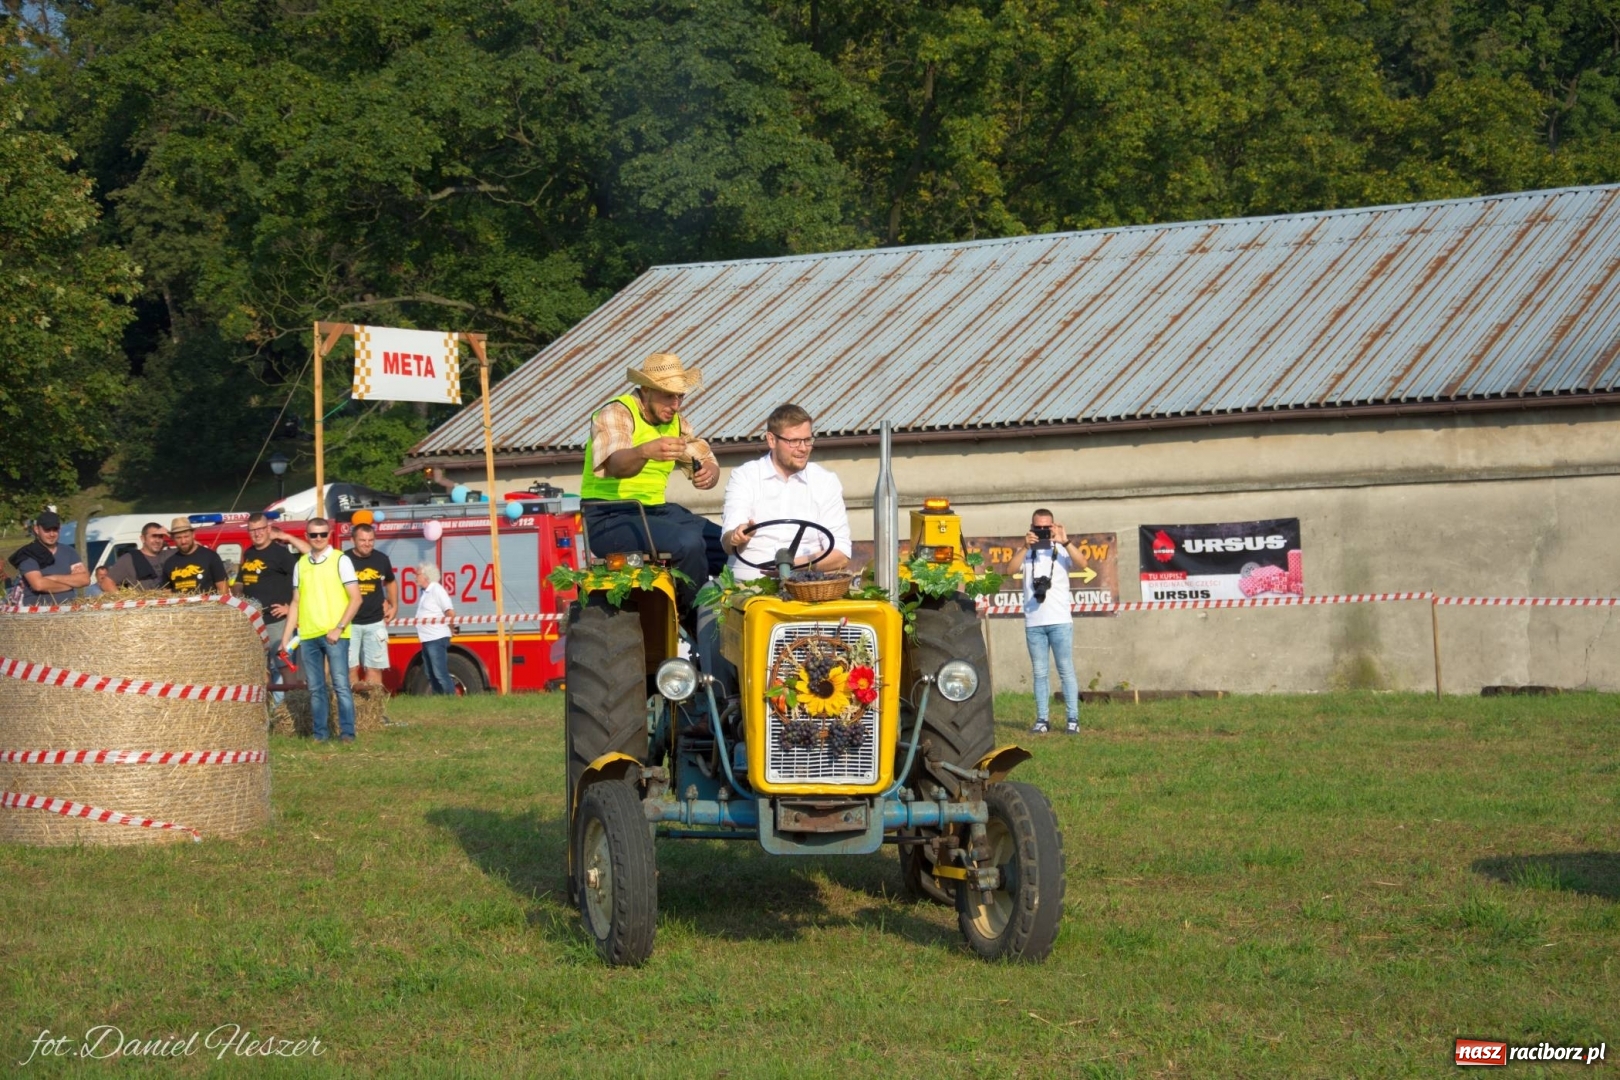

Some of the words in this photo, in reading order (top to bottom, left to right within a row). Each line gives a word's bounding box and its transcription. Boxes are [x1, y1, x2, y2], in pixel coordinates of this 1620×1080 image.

[383, 352, 435, 378] META
[518, 518, 535, 526] 112
[1182, 535, 1287, 554] URSUS
[461, 564, 497, 602] 24
[1160, 572, 1183, 580] KUPISZ
[1154, 589, 1211, 601] URSUS
